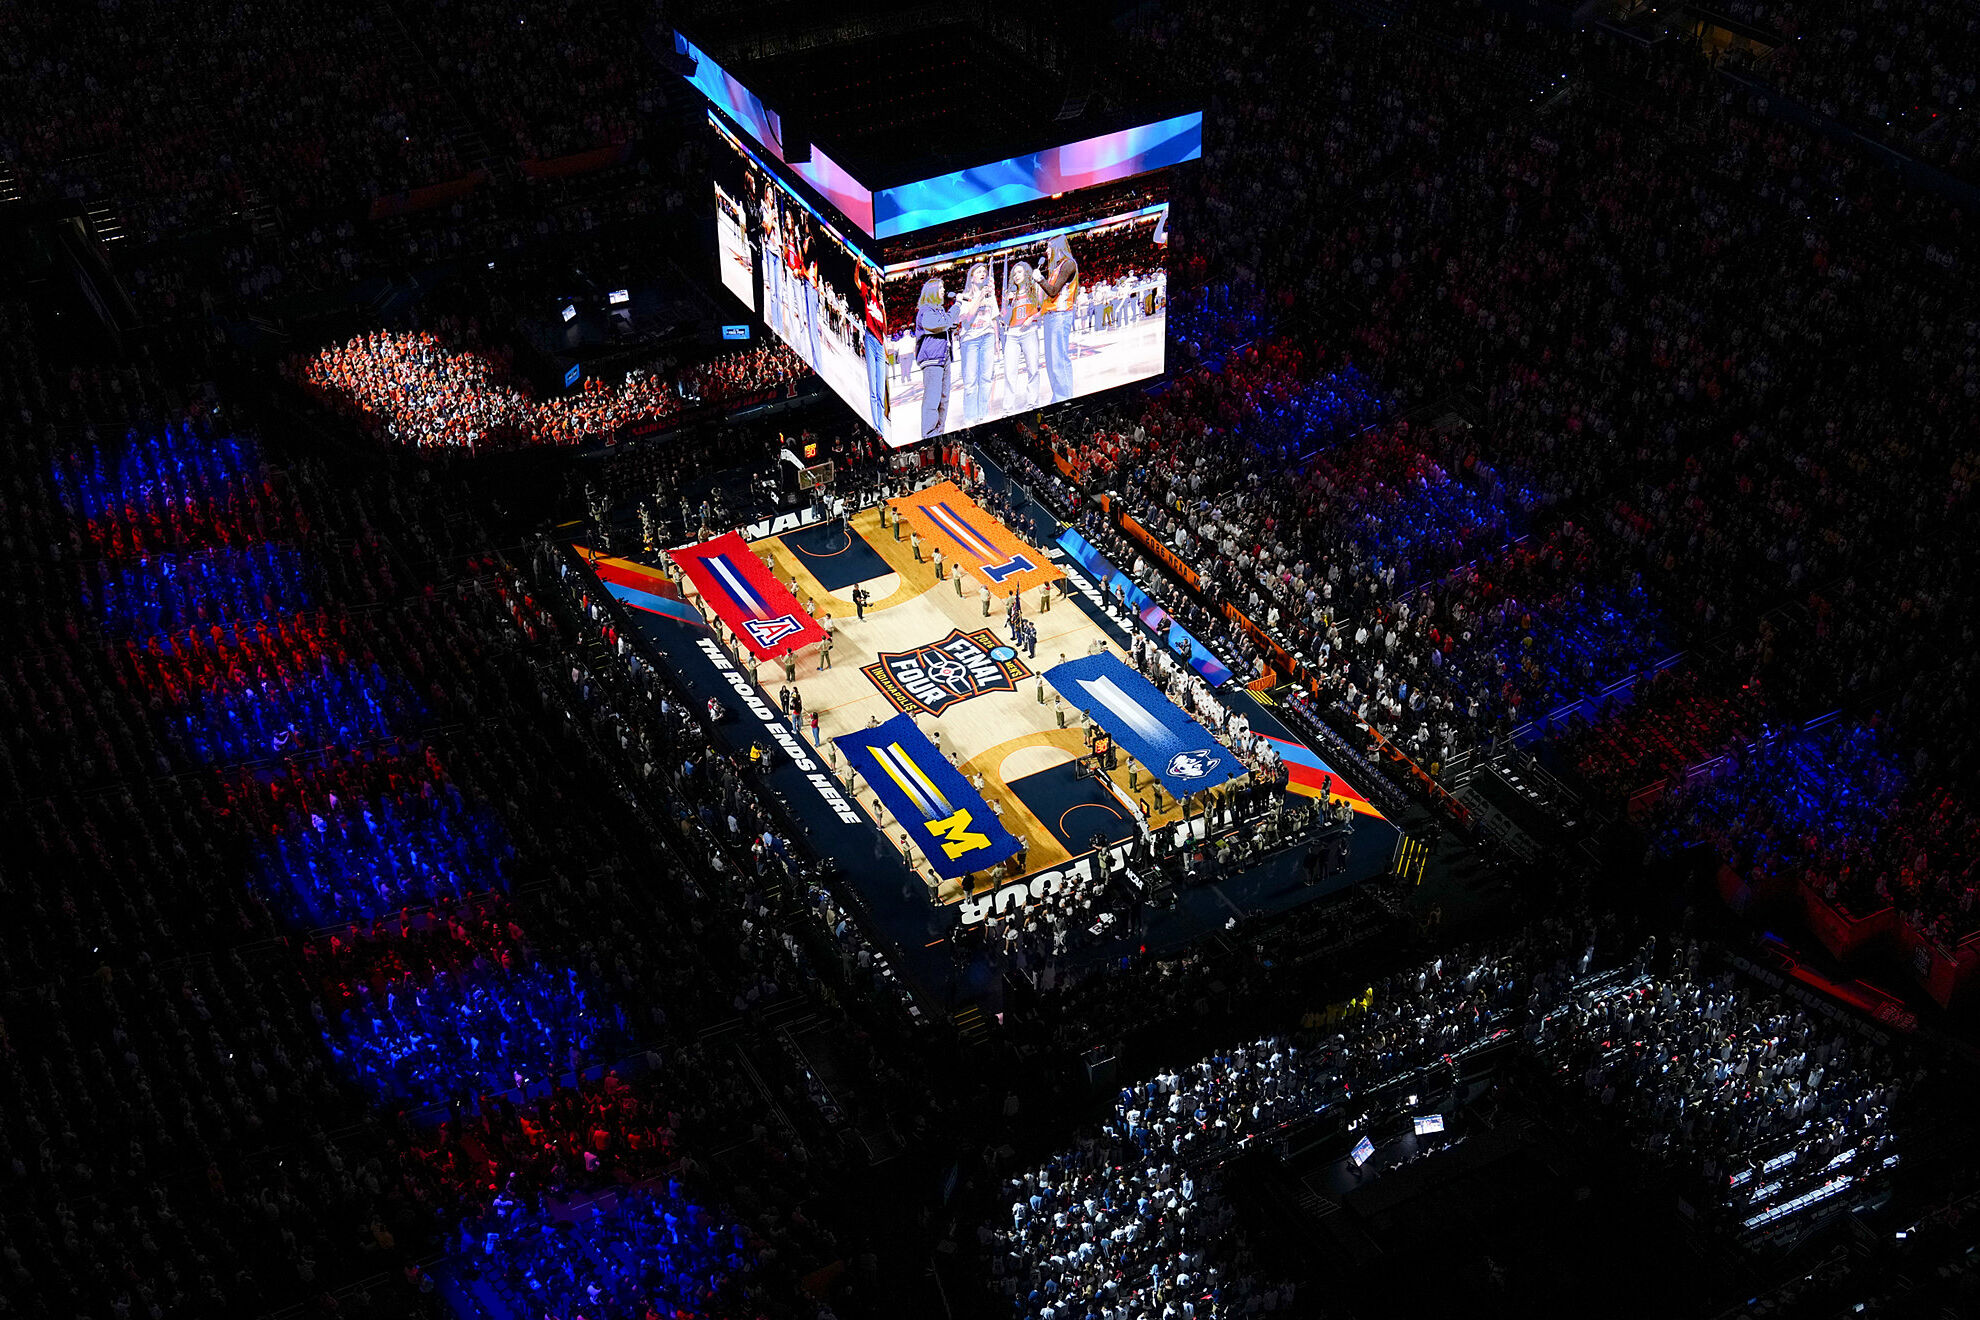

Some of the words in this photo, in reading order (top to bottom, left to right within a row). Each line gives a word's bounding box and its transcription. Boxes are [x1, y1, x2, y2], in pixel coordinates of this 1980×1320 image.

[1145, 535, 1165, 557] 2026
[742, 614, 804, 649] A
[890, 658, 948, 706] FOUR
[943, 638, 1004, 687] FINAL
[871, 667, 918, 712] INDIANAPOLIS
[696, 637, 734, 669] THE
[722, 672, 774, 721] ROAD
[764, 723, 817, 771] ENDS
[806, 774, 862, 824] HERE
[924, 808, 992, 859] M
[1125, 867, 1144, 890] NCAA
